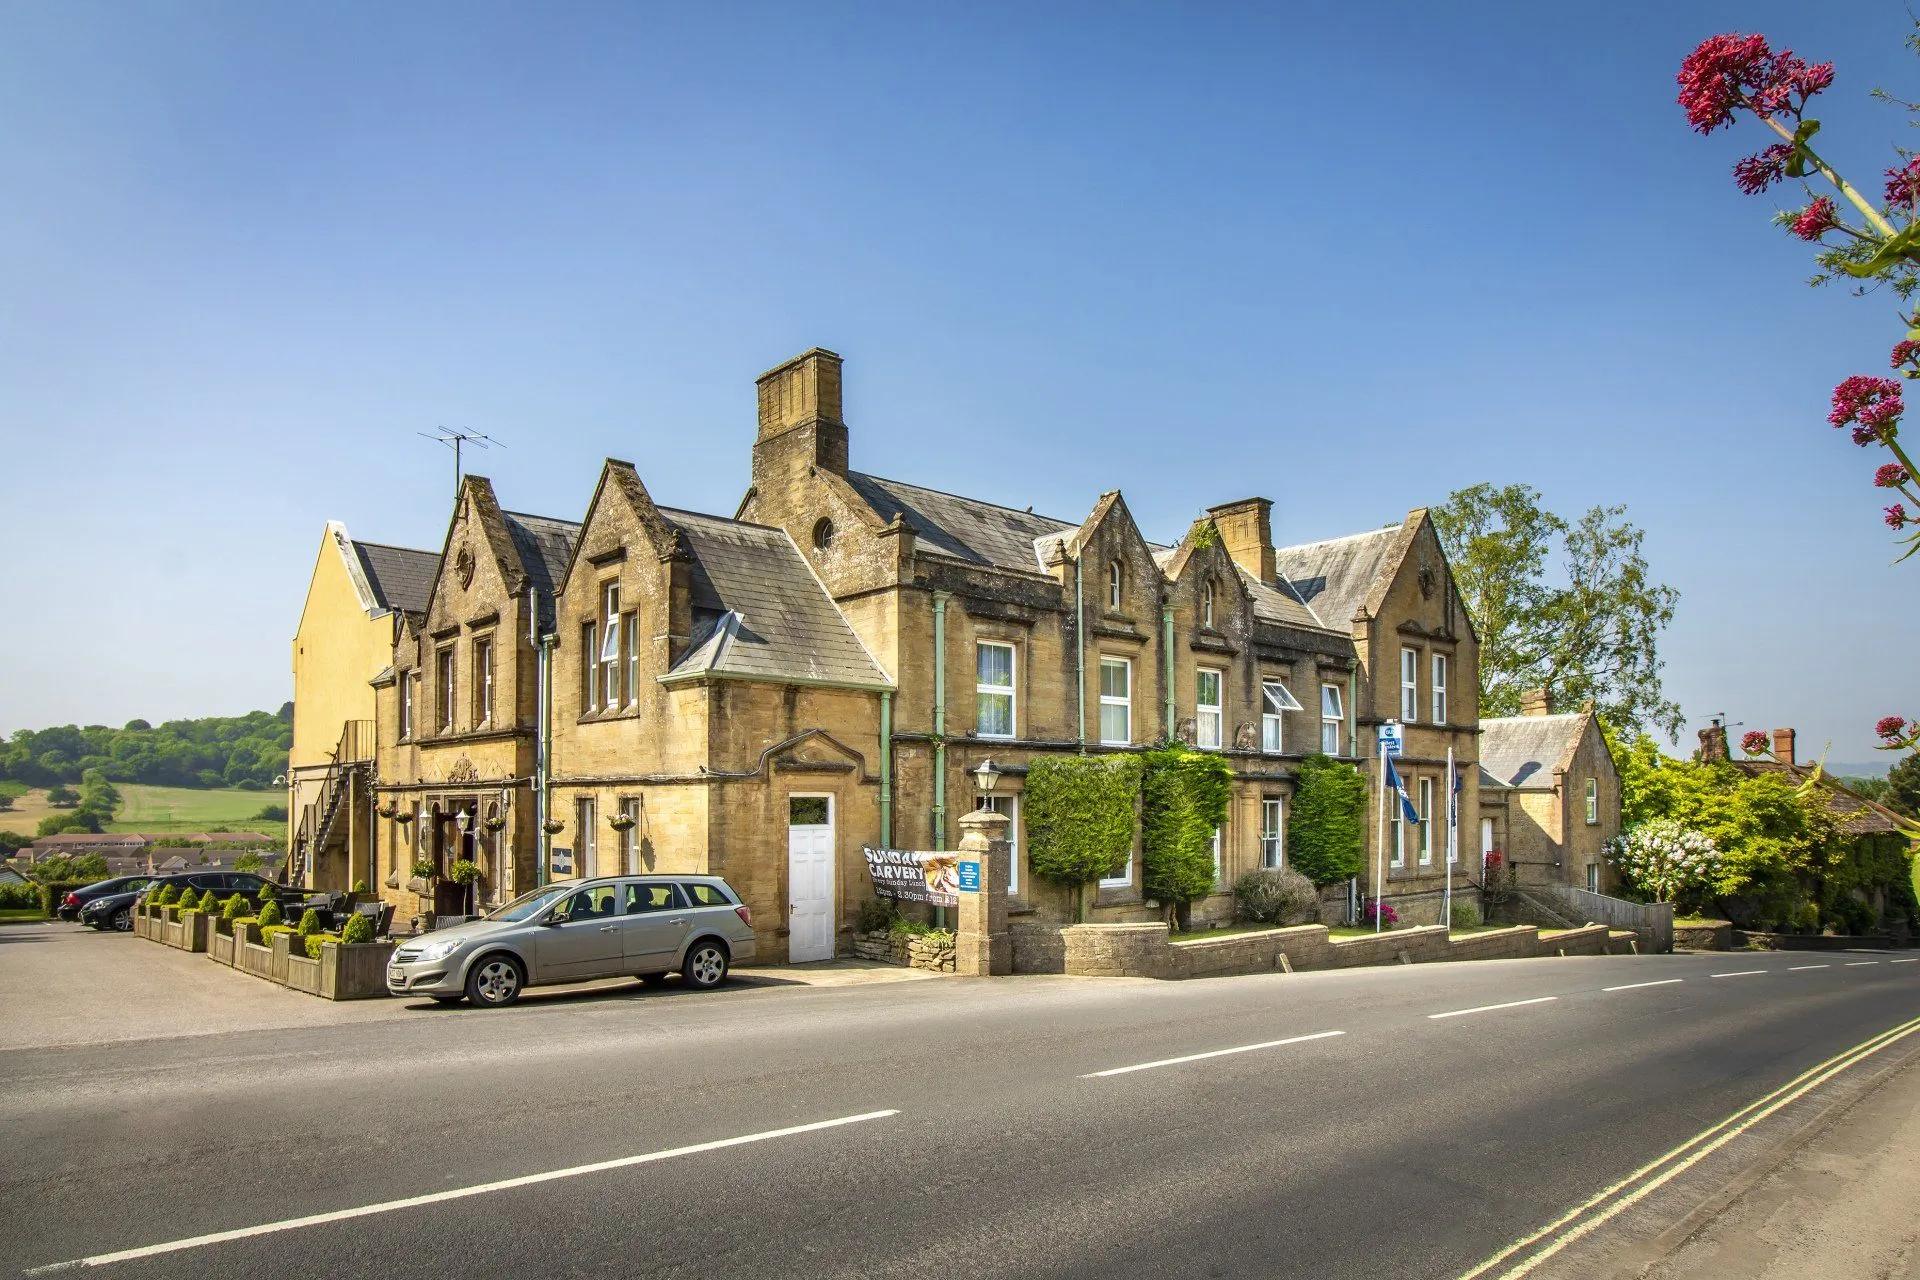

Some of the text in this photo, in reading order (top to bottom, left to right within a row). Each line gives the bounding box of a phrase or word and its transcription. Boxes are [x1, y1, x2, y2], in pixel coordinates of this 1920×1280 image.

[864, 848, 923, 866] SUNDAY
[868, 863, 924, 880] CARVERY
[886, 879, 908, 887] Sunday
[925, 893, 943, 903] from
